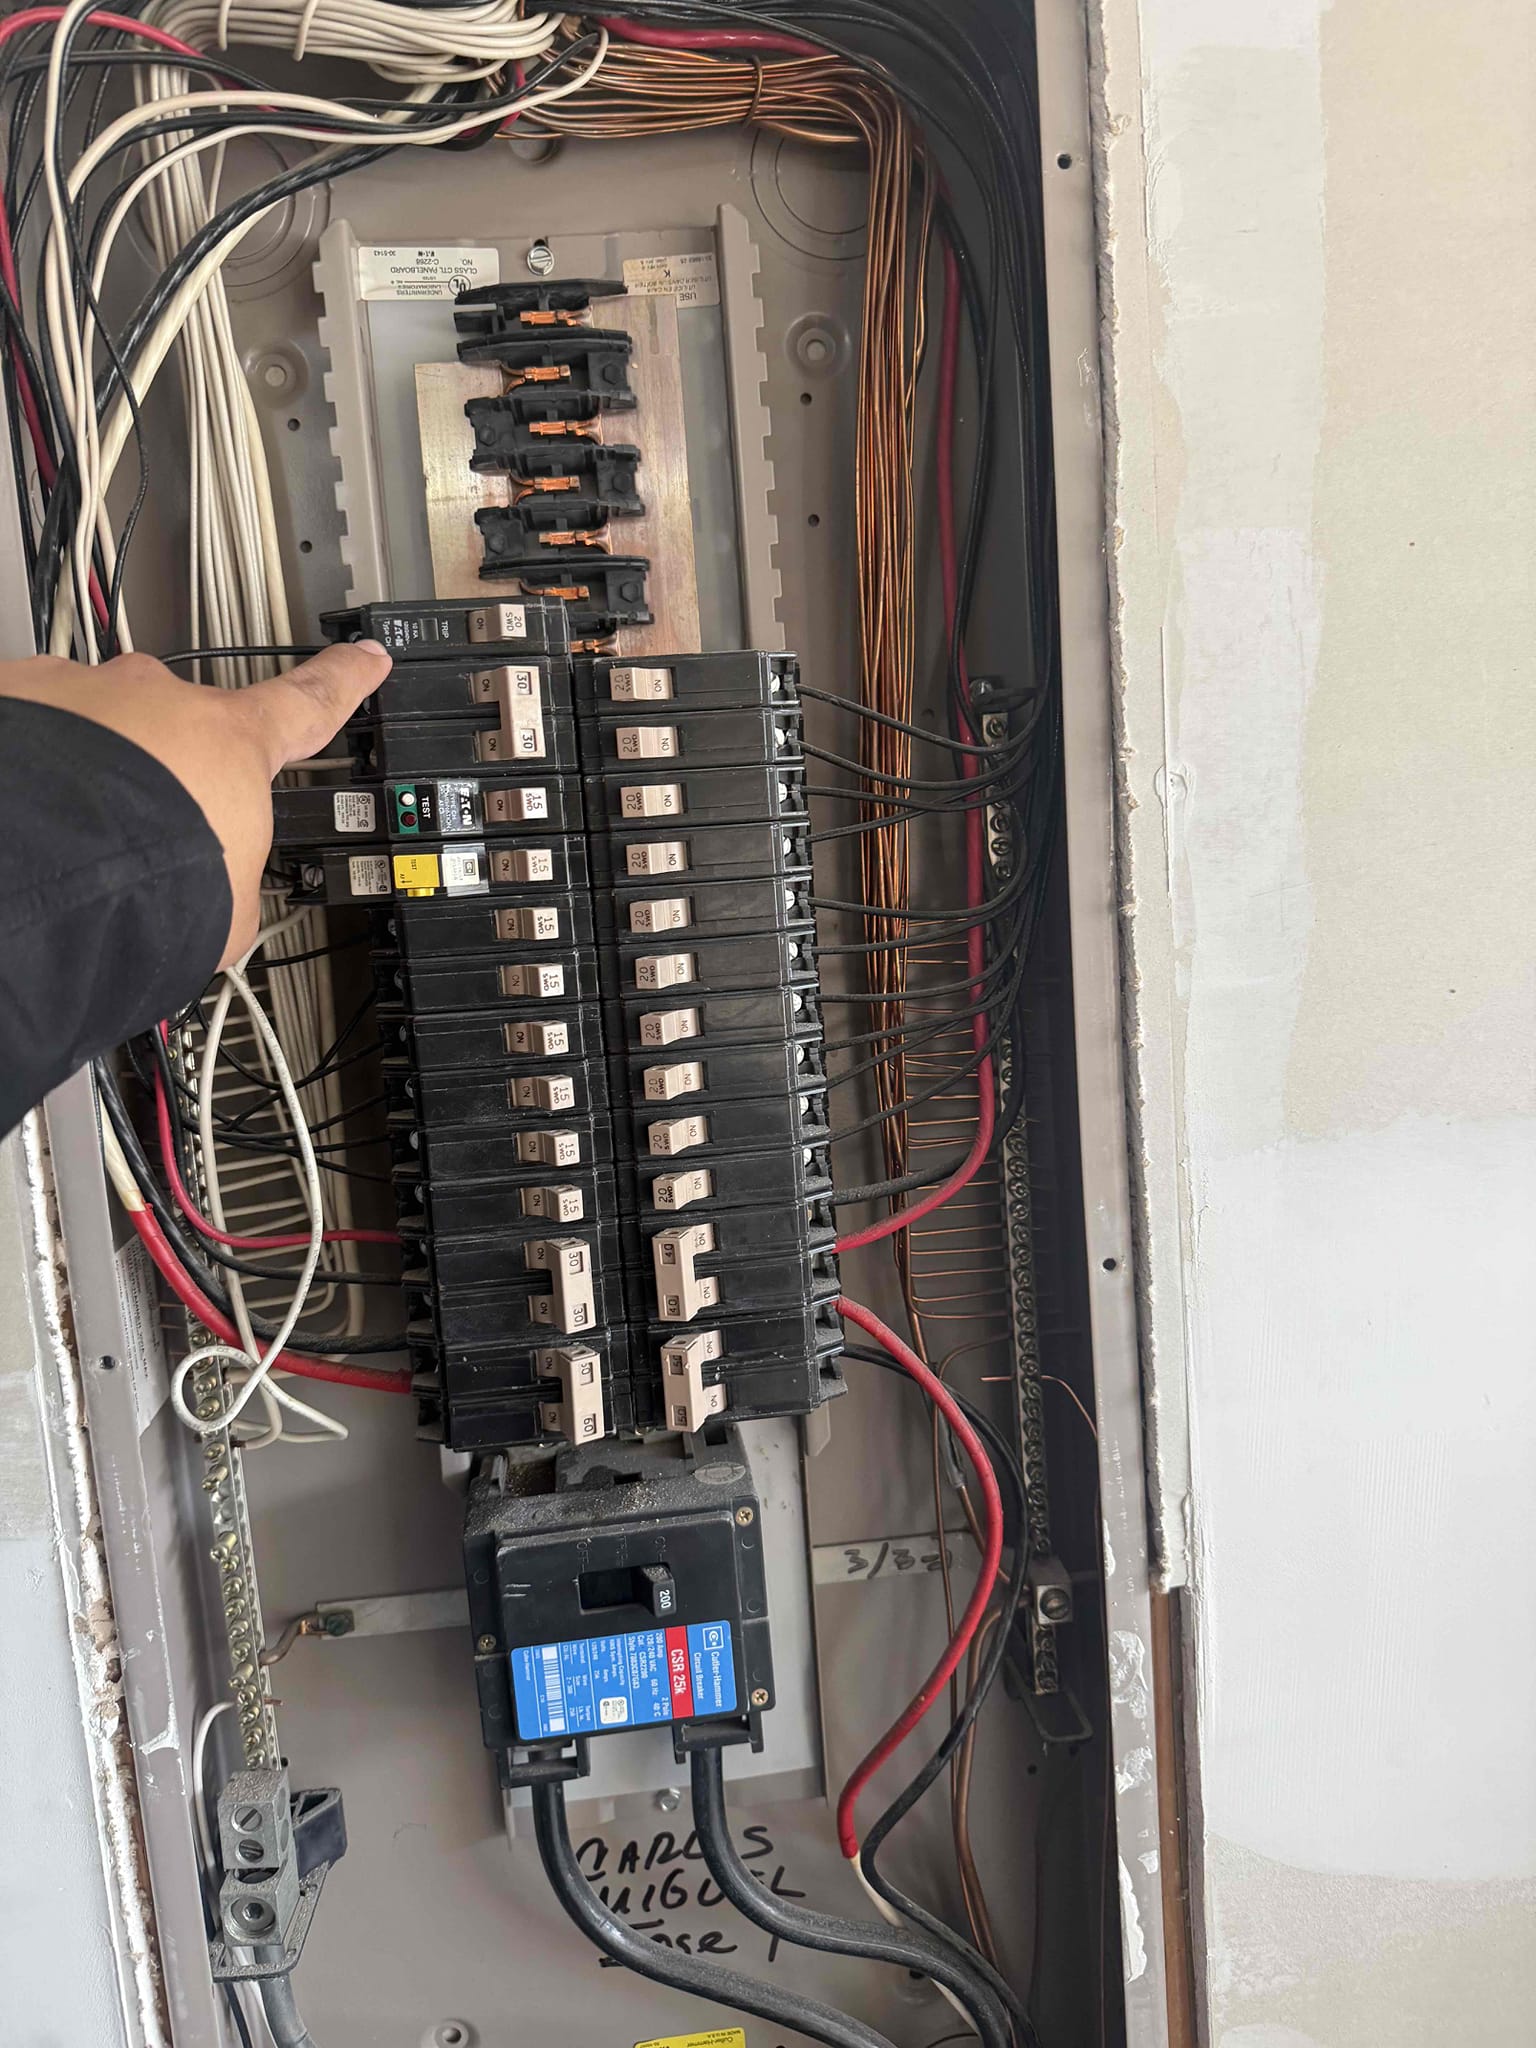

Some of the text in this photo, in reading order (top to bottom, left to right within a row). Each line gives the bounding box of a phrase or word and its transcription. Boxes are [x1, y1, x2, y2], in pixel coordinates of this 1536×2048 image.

[680, 292, 696, 301] USE
[477, 618, 484, 630] ON
[505, 612, 514, 631] SWD
[514, 616, 522, 628] 20
[441, 620, 449, 638] TRIP
[482, 679, 490, 692] ON
[516, 674, 527, 689] 30
[614, 674, 625, 691] 20
[654, 679, 662, 692] ON
[488, 738, 496, 751] ON
[522, 734, 533, 749] 30
[622, 737, 632, 753] 20
[661, 738, 670, 751] ON
[497, 799, 503, 811] ON
[532, 795, 543, 810] 15
[626, 794, 636, 810] 20
[664, 794, 672, 807] ON
[421, 796, 431, 819] TEST
[502, 859, 509, 871] ON
[538, 858, 549, 872] 15
[631, 852, 641, 868] 20
[668, 853, 677, 865] ON
[635, 911, 644, 926] 20
[672, 909, 680, 922] ON
[506, 918, 515, 931] ON
[544, 917, 555, 931] 15
[640, 966, 649, 982] 20
[677, 962, 685, 975] ON
[511, 974, 520, 986] ON
[549, 974, 559, 988] 15
[645, 1023, 655, 1039] 20
[681, 1020, 689, 1033] ON
[516, 1031, 524, 1044] ON
[553, 1032, 564, 1046] 15
[648, 1078, 658, 1093] 20
[684, 1073, 692, 1085] ON
[522, 1085, 531, 1098] ON
[559, 1087, 570, 1101] 15
[689, 1124, 697, 1137] ON
[529, 1141, 536, 1153] ON
[653, 1134, 663, 1149] 20
[565, 1143, 575, 1157] 15
[694, 1176, 702, 1190] ON
[533, 1194, 541, 1206] ON
[657, 1187, 668, 1203] 20
[569, 1199, 579, 1213] 15
[699, 1233, 706, 1246] ON
[537, 1248, 545, 1260] ON
[664, 1244, 673, 1258] 40
[568, 1252, 579, 1267] 30
[703, 1286, 710, 1299] ON
[540, 1302, 548, 1315] ON
[668, 1299, 677, 1313] 40
[573, 1307, 584, 1323] 30
[706, 1341, 713, 1353] ON
[545, 1357, 553, 1369] ON
[711, 1395, 717, 1407] ON
[549, 1411, 557, 1423] ON
[677, 1409, 686, 1422] 50
[583, 1417, 593, 1432] 60
[659, 1589, 672, 1609] 200
[656, 1645, 664, 1658] Amp
[671, 1649, 686, 1694] CSR 25k
[694, 1653, 704, 1700] Circuit Breaker
[711, 1651, 722, 1707] Cutler-Hammer
[652, 1688, 658, 1696] Hz
[687, 2037, 733, 2047] Cutler-Hammer
